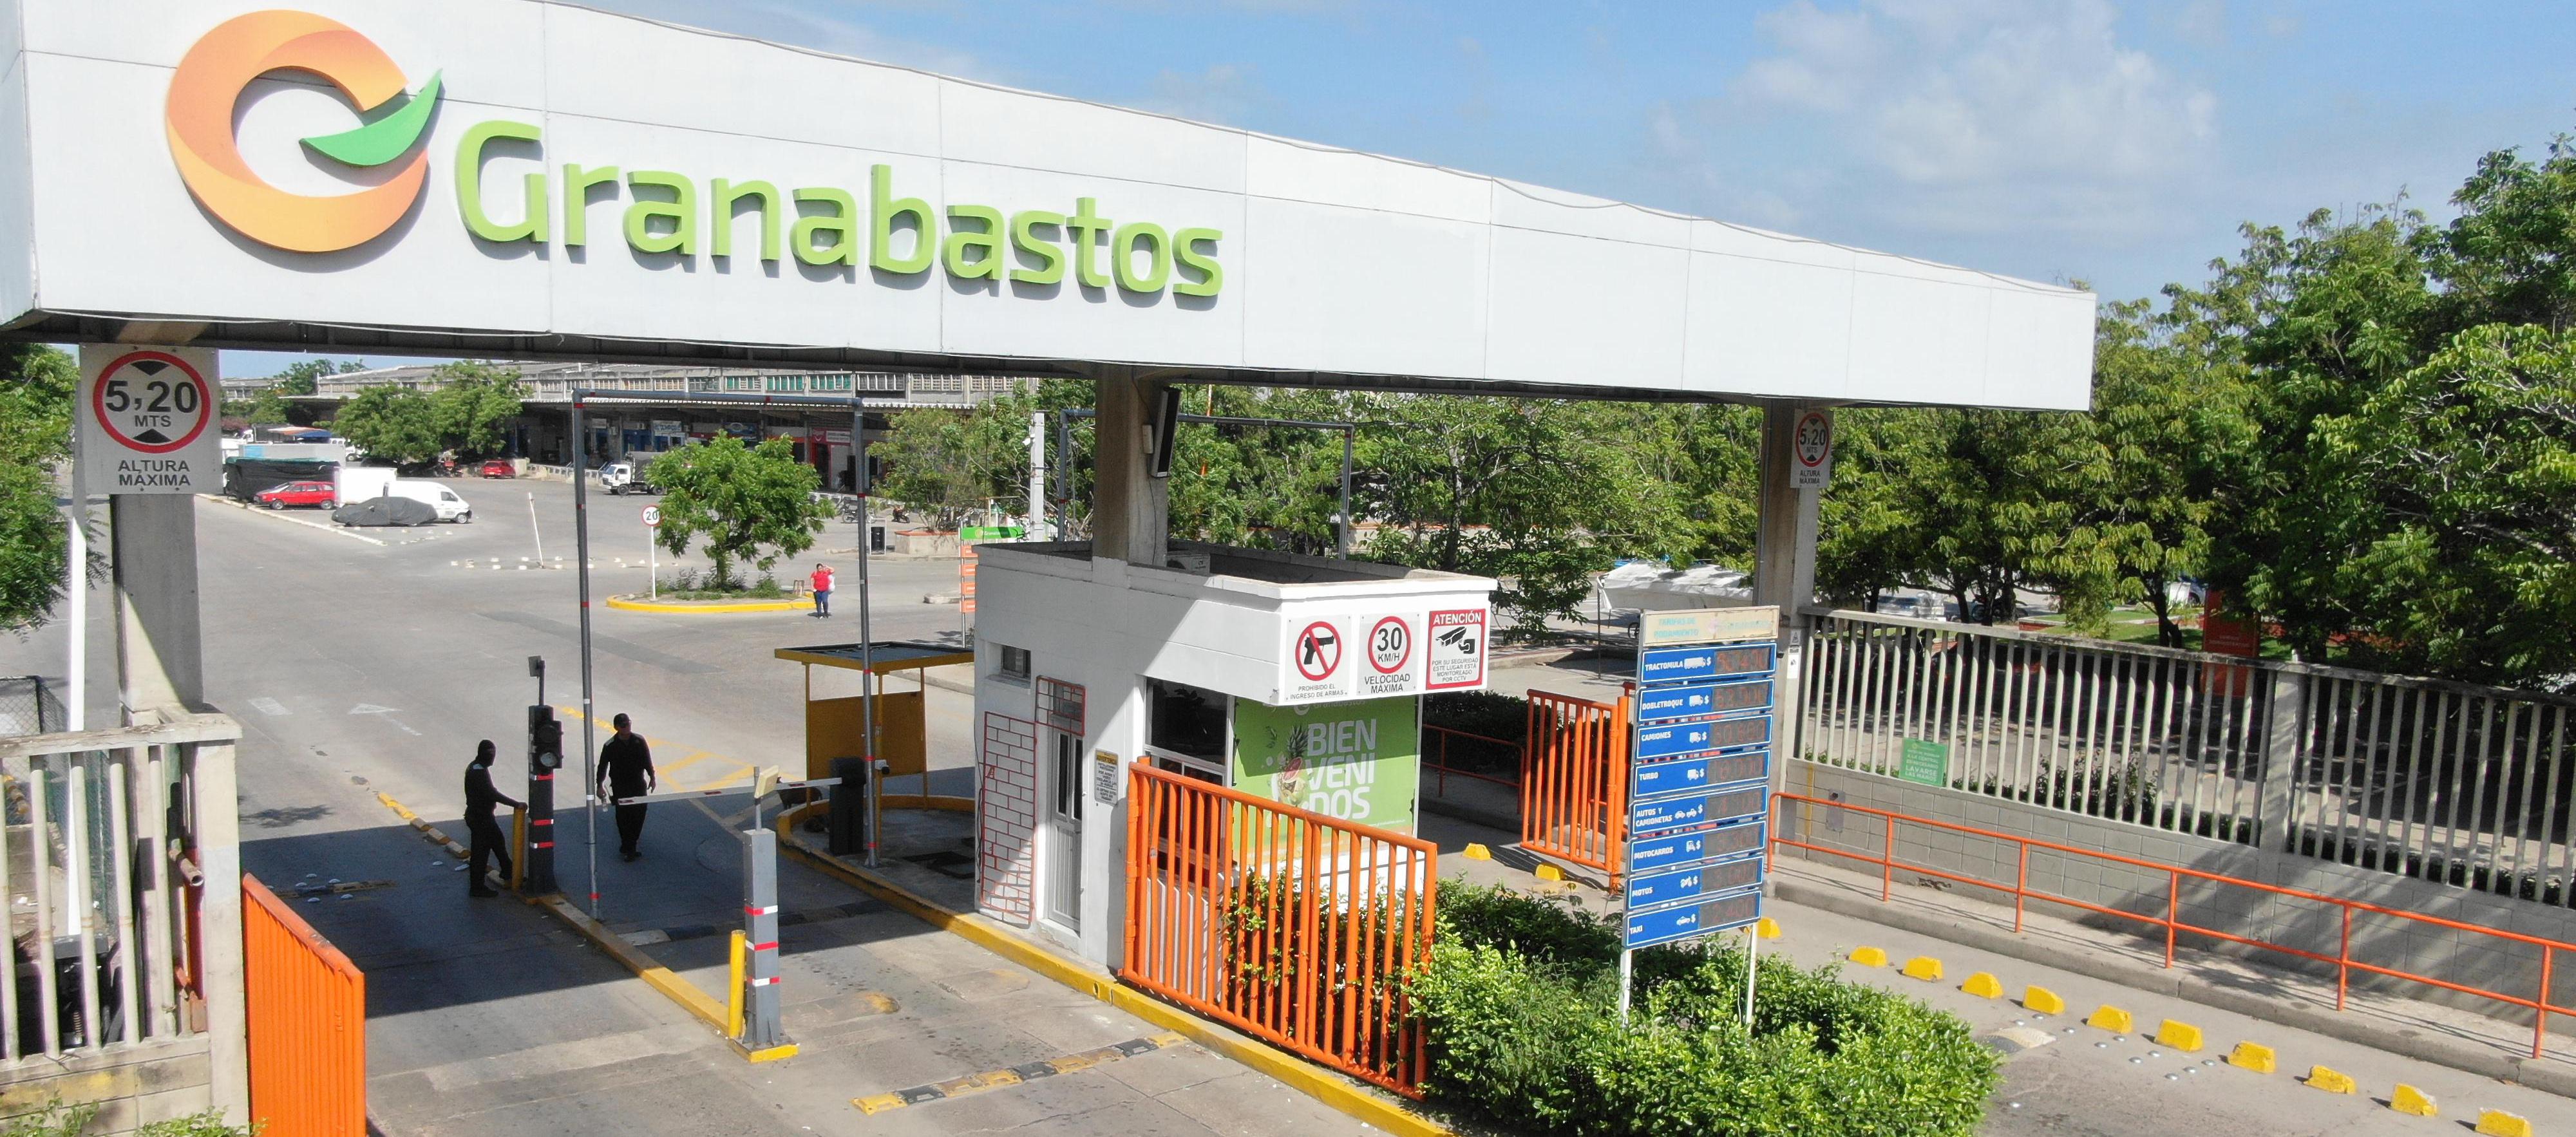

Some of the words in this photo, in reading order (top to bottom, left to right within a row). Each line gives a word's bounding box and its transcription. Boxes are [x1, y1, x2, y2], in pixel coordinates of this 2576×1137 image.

[455, 120, 1224, 297] Granabastos
[106, 381, 198, 413] 5,20
[135, 415, 171, 428] MTS
[1799, 428, 1826, 446] 5,20
[118, 460, 191, 472] ALTURA
[118, 471, 191, 486] MÁXIMA
[645, 511, 658, 520] 20
[1433, 610, 1481, 625] ATENCIÓN
[1378, 627, 1402, 652] 30
[1378, 653, 1400, 662] KM/H
[1645, 661, 1683, 671] TRACTOMULA
[1365, 673, 1410, 685] VELOCIDAD
[1642, 699, 1684, 710] DOBLETROQUE
[1307, 719, 1377, 756] BIEN
[1641, 731, 1672, 742] CAMIONES
[1305, 752, 1376, 791] VENI
[1638, 771, 1659, 781] TURBO
[1309, 787, 1370, 820] DOS
[1636, 808, 1656, 818] AUTOS
[1636, 814, 1672, 827] CAMIONETAS
[1634, 846, 1674, 860] MOTOCARROS
[1632, 886, 1653, 897] MOTOS
[1629, 925, 1643, 935] TAXI
